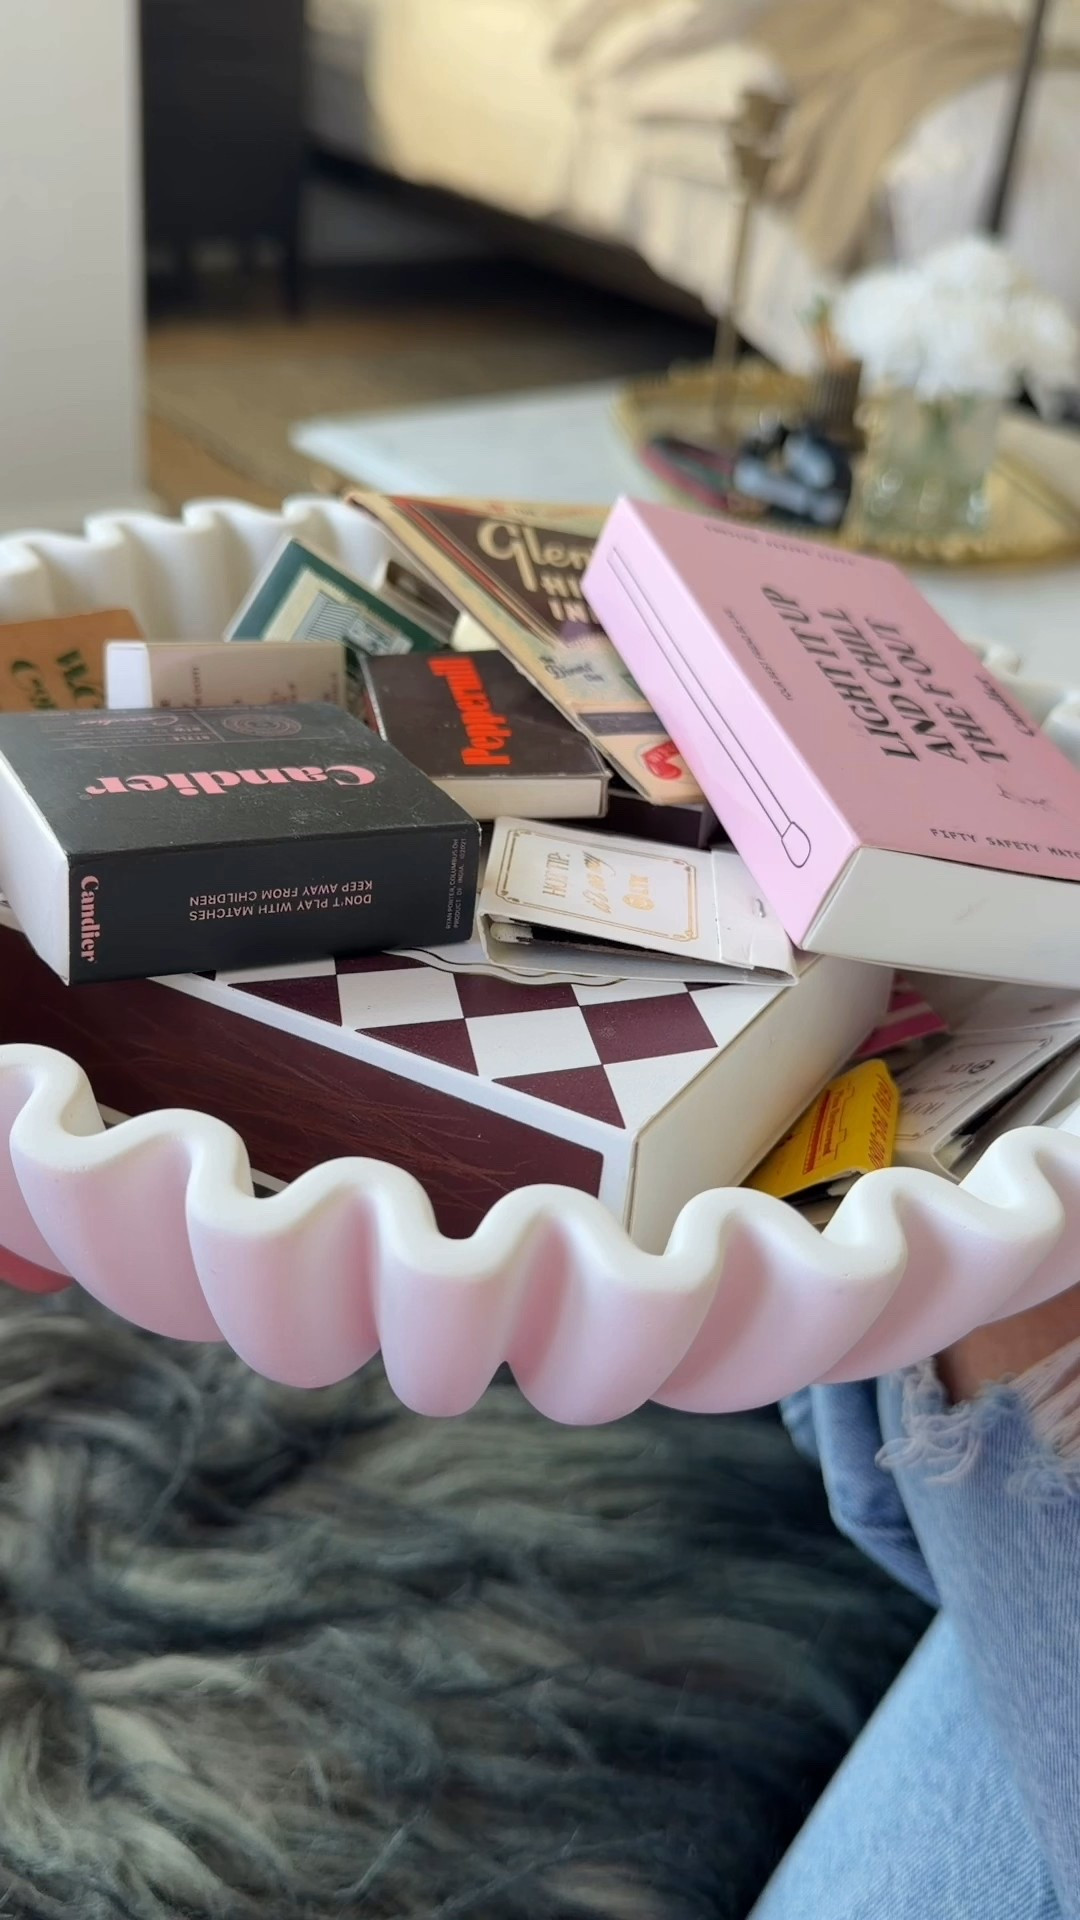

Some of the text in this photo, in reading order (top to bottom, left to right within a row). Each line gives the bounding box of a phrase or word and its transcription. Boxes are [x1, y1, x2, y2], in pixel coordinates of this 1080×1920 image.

[761, 586, 920, 762] LIGHT IT UP
[817, 607, 969, 765] AND CHILL
[864, 617, 1010, 763] THE F OUT
[86, 764, 377, 796] Candier
[929, 828, 977, 843] FIFTY
[986, 837, 1041, 853] SAFETY
[189, 880, 373, 906] KEEP AWAY FROM CHILDREN
[189, 894, 372, 921] DON'T PLAY WITH MATCHES
[80, 875, 101, 963] Candier
[453, 899, 461, 929] PRODUCT
